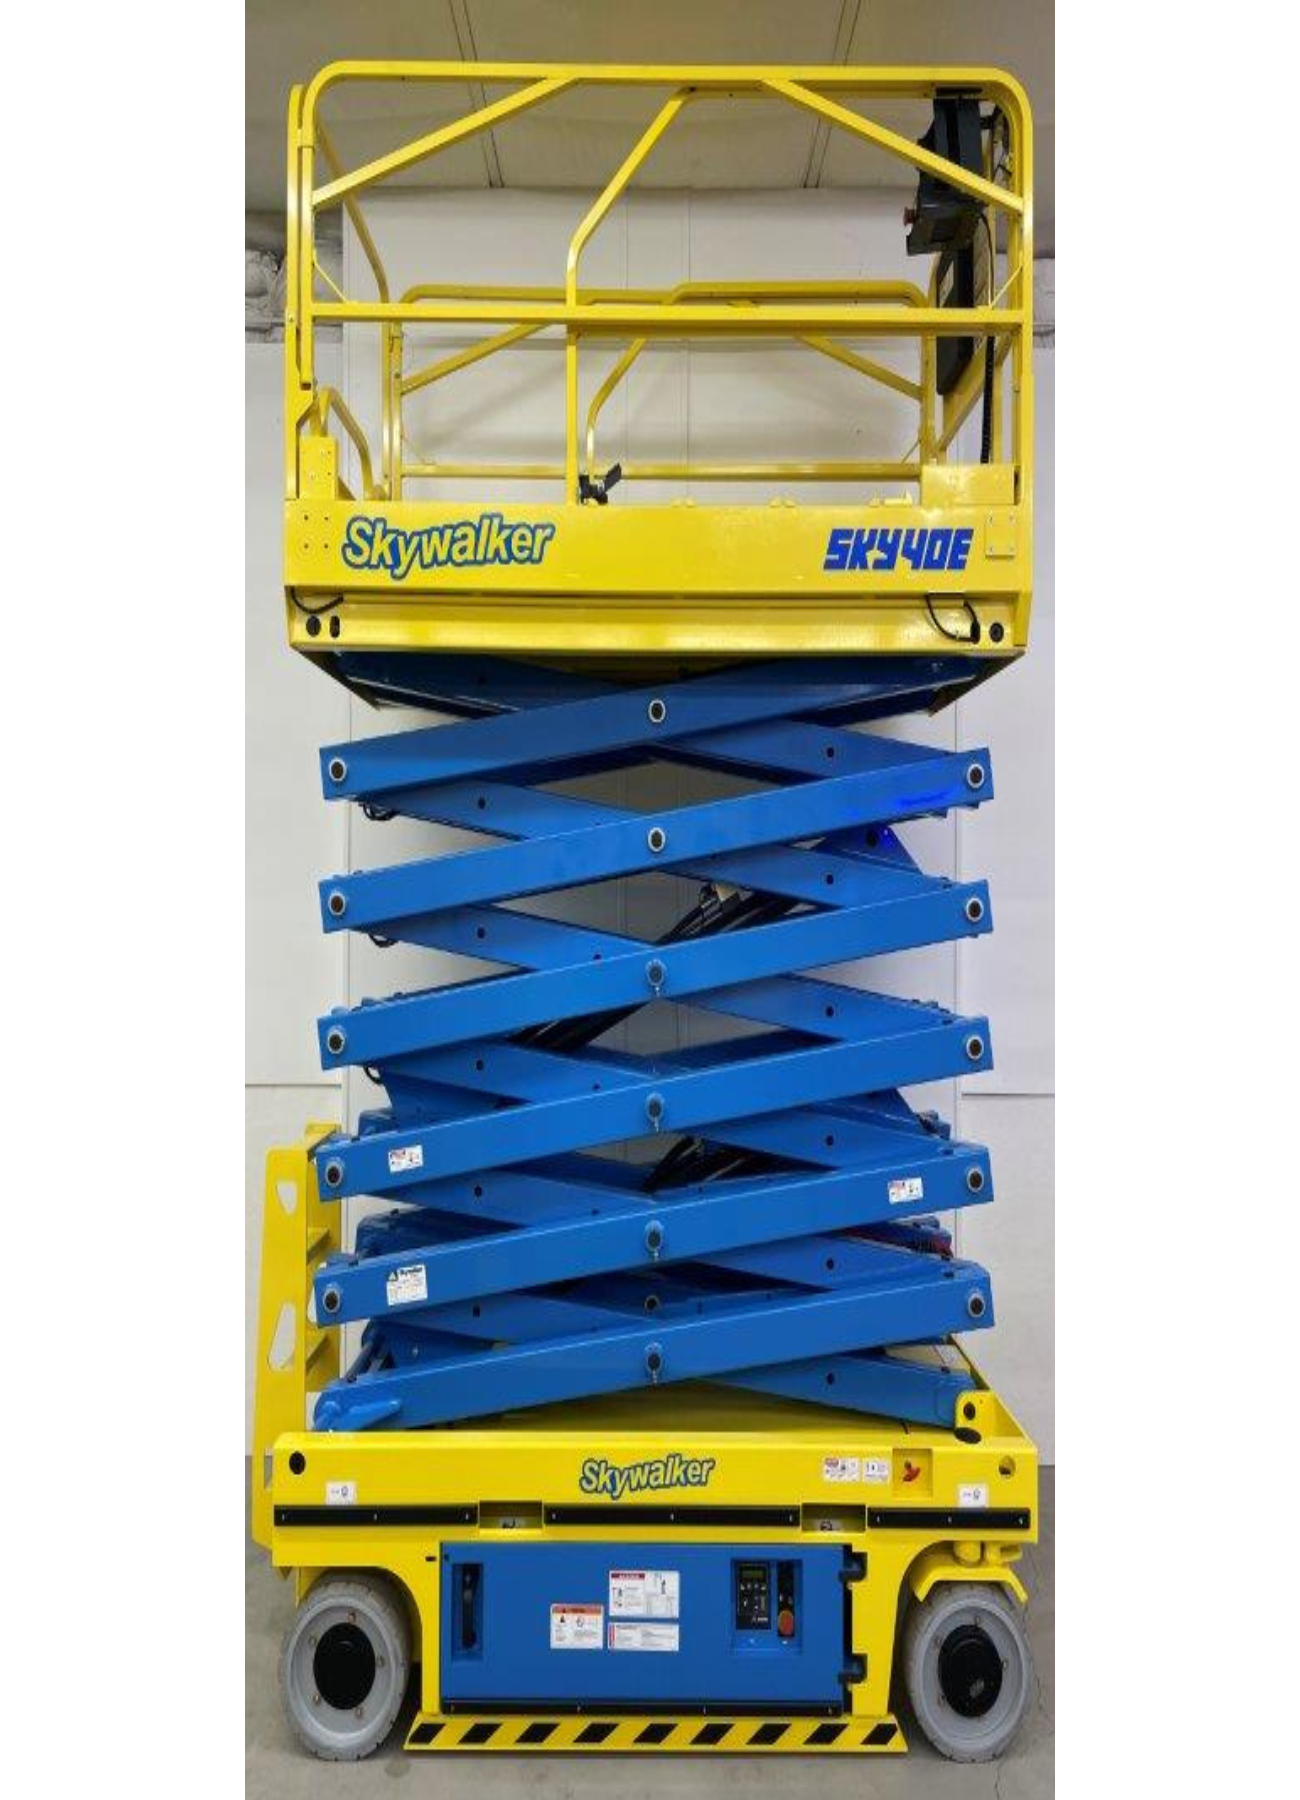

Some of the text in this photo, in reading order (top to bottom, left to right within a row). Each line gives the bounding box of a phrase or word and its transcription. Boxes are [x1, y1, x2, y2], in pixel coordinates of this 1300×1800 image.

[342, 514, 555, 580] Skywalker
[823, 528, 974, 571] SKY40E
[581, 1454, 715, 1498] Skywalker
